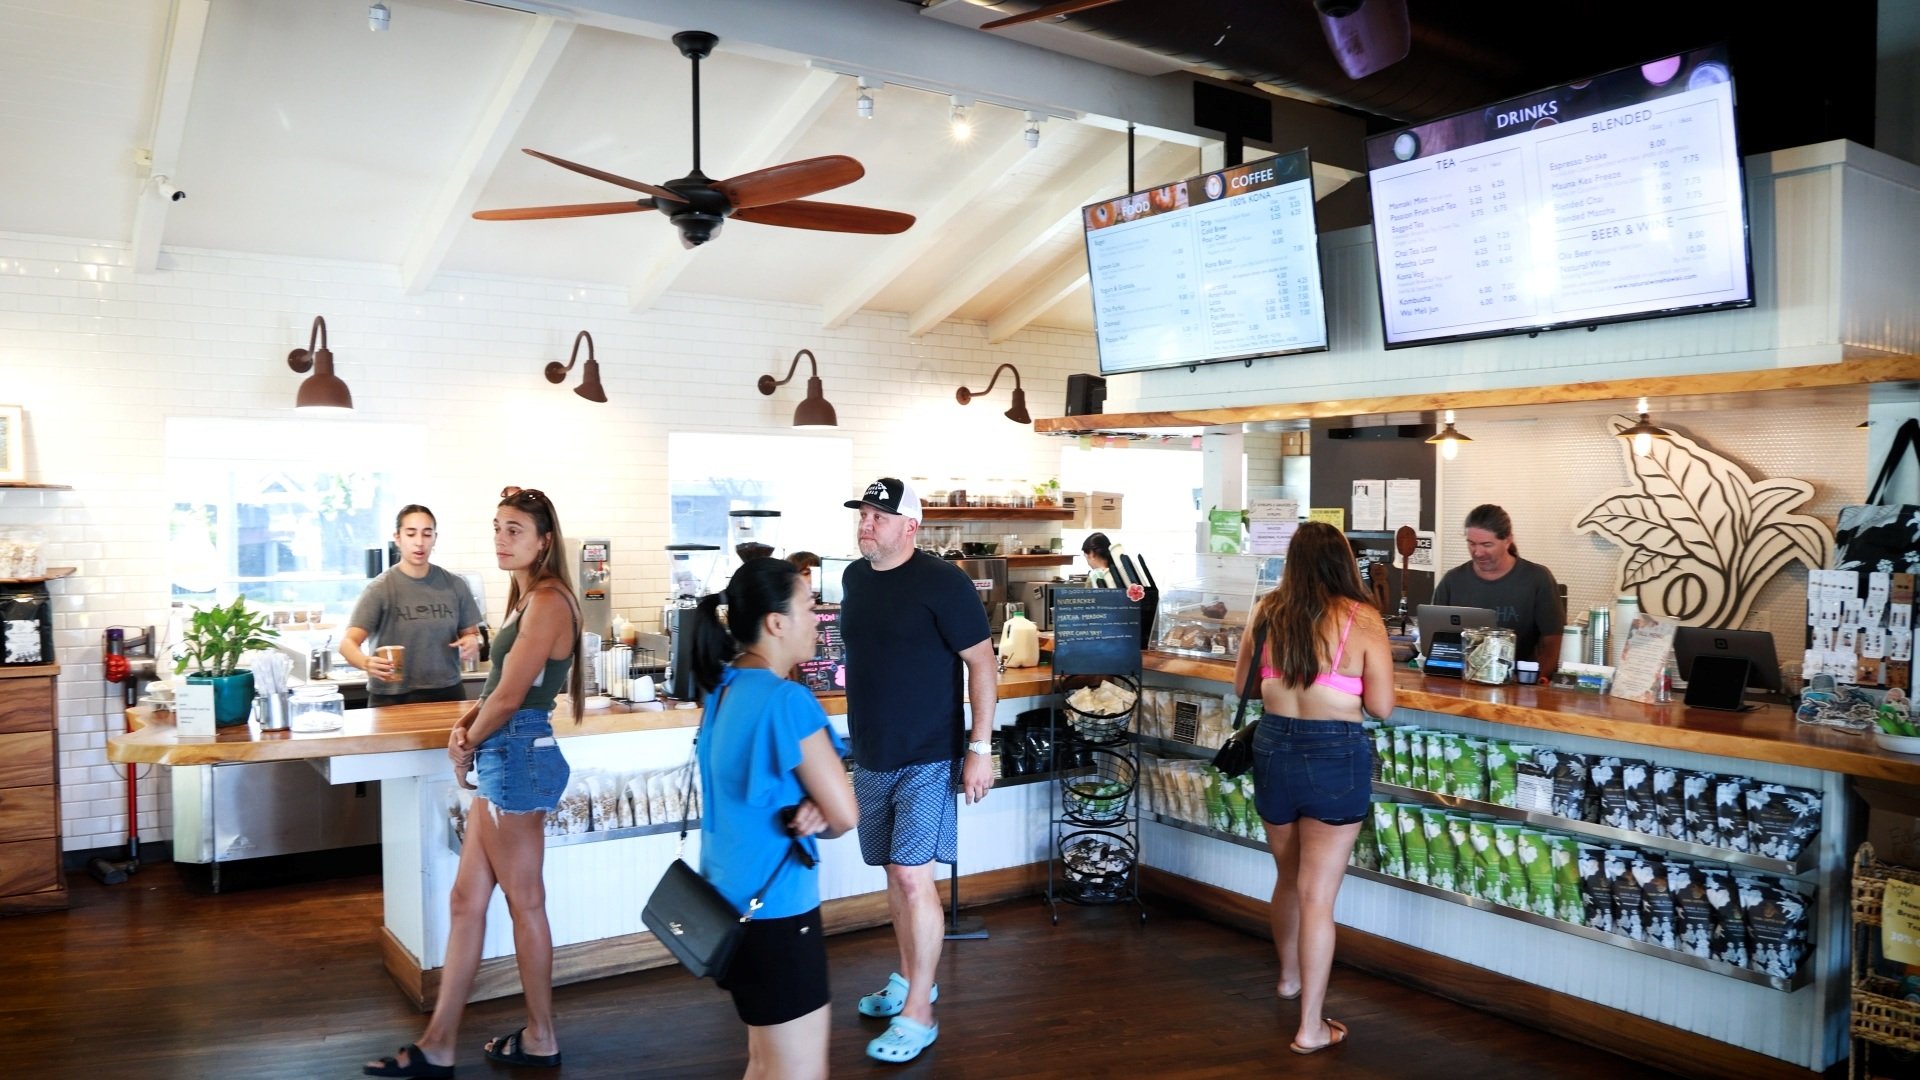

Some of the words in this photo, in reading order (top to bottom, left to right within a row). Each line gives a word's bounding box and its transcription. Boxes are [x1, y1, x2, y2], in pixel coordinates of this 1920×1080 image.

[1496, 100, 1559, 129] DRINKS
[1591, 109, 1653, 133] BLENDED
[1549, 158, 1583, 171] Espresso
[1584, 152, 1608, 164] Shake
[1649, 138, 1667, 149] 8.00
[1435, 158, 1456, 171] TEA
[1551, 179, 1577, 191] Mauna
[1578, 177, 1593, 186] Kea
[1594, 171, 1622, 183] Freeze
[1682, 153, 1700, 164] 7.75
[1231, 168, 1274, 189] COFFEE
[1229, 196, 1247, 208] 100%
[1248, 191, 1272, 203] KONA
[1122, 201, 1150, 217] FOOD
[1390, 211, 1413, 222] Passion
[1414, 208, 1430, 217] Fruit
[1431, 205, 1445, 214] Iced
[1445, 202, 1457, 211] Tea
[1591, 225, 1621, 241] BEER
[1625, 224, 1634, 235] &
[1636, 216, 1675, 232] WINE
[1575, 248, 1593, 258] Beer
[1591, 258, 1611, 269] Wine
[1399, 295, 1432, 306] Kombucha
[1057, 614, 1080, 622] MATCHA
